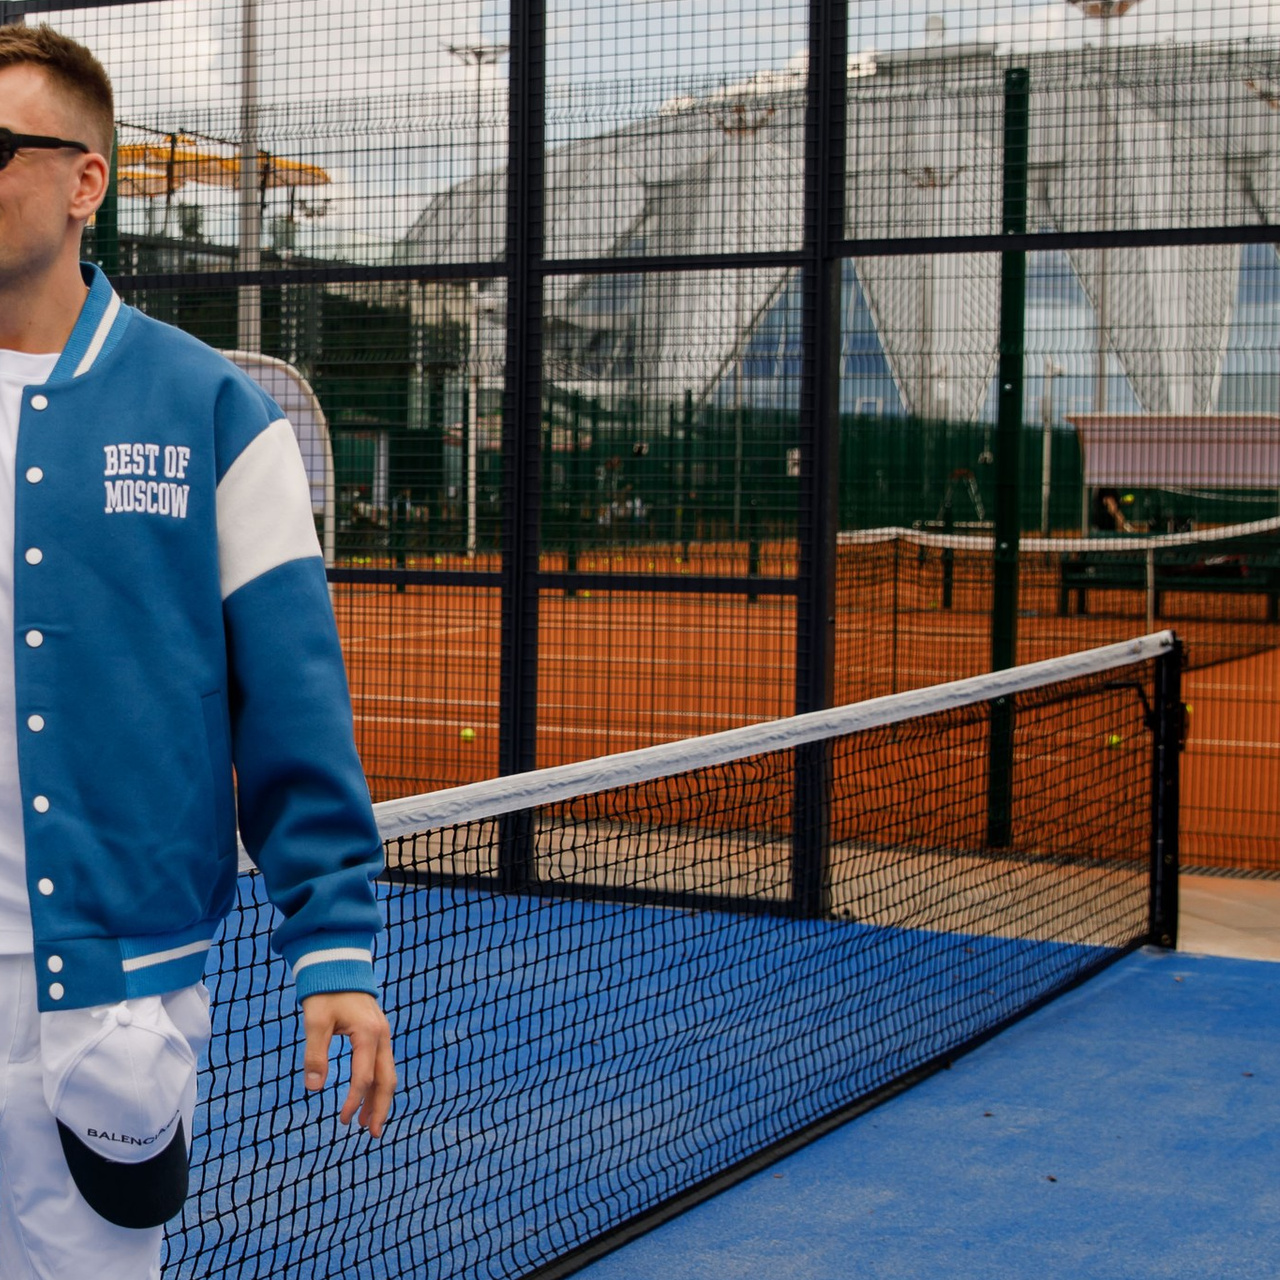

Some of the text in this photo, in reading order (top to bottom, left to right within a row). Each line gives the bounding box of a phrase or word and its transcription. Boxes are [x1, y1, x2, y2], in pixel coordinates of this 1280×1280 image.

[104, 443, 191, 479] BEST OF
[104, 479, 190, 519] MOSCOW
[86, 1108, 181, 1147] BALENCIA
